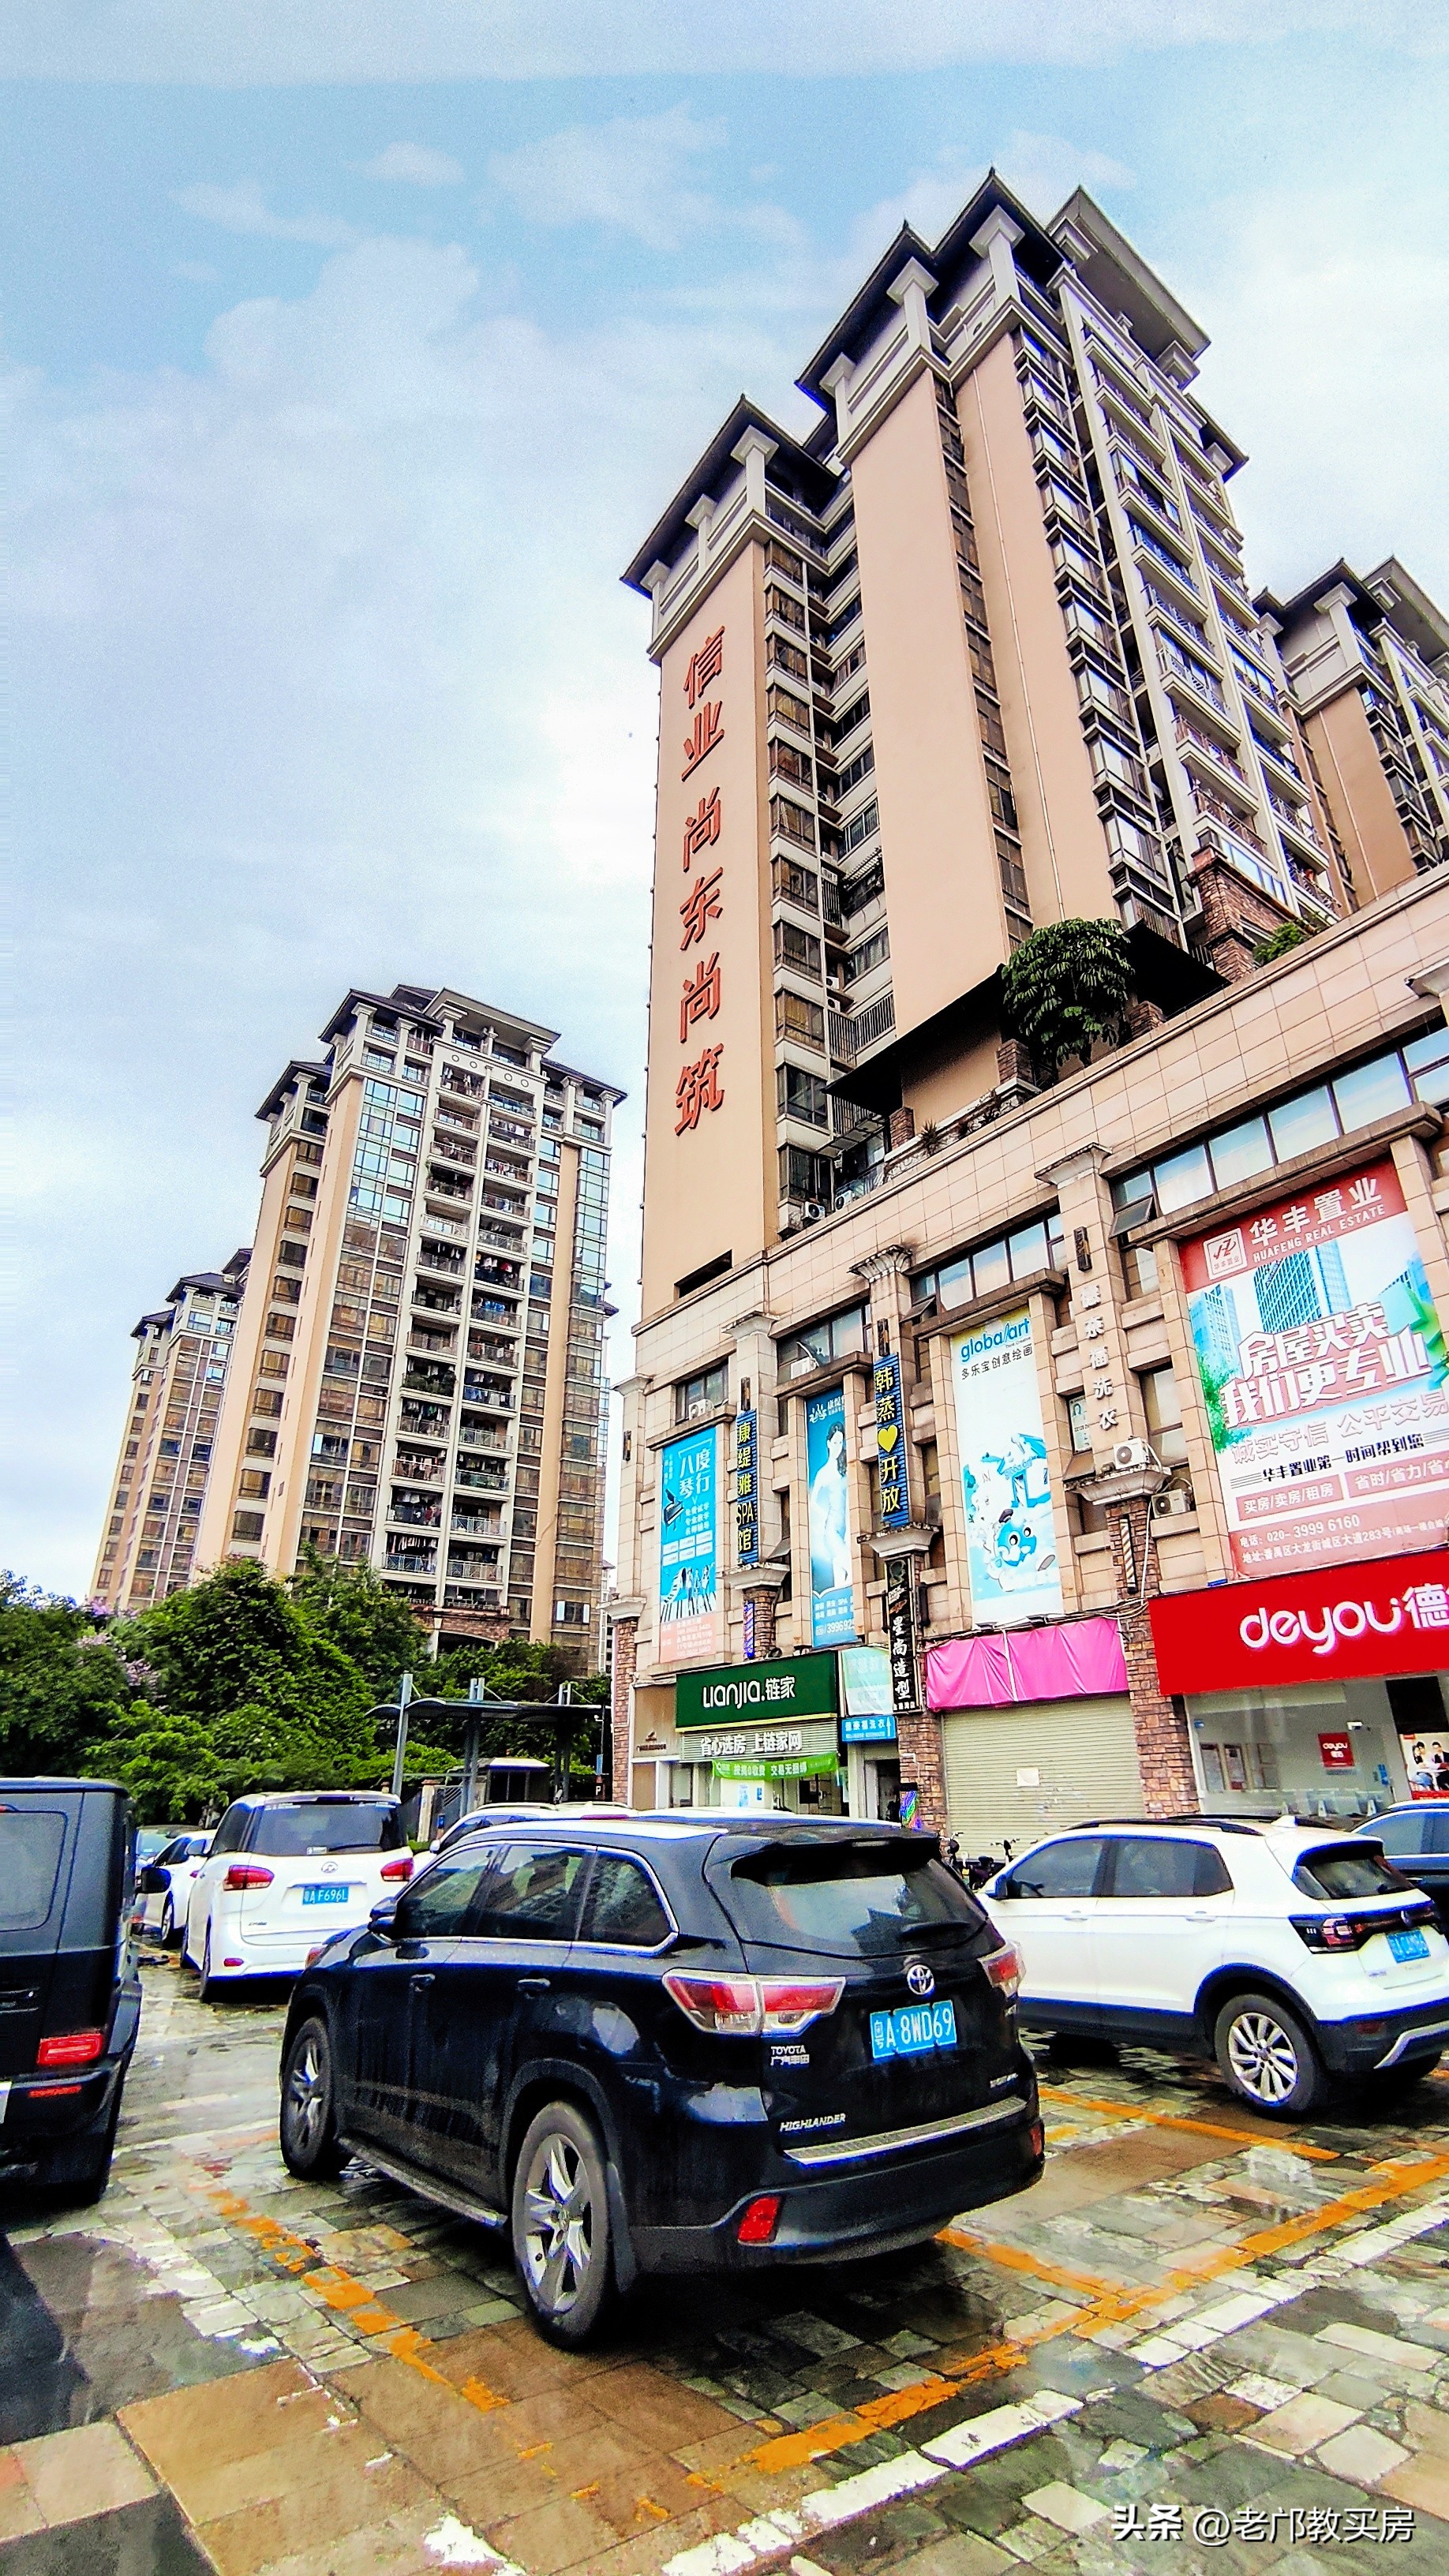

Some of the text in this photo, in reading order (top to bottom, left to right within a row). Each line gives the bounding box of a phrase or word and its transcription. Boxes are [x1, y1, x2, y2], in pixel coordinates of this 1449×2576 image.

[676, 625, 725, 1136] 信业尚东尚筑
[1249, 1177, 1381, 1247] 华丰置业
[1252, 1204, 1386, 1263] HUAFENG REAL ESTATE
[961, 1343, 1033, 1380] 多乐宝创意绘画
[1238, 1301, 1389, 1381] 房屋买卖
[1221, 1324, 1432, 1428] 我们更专业
[1233, 1391, 1449, 1465] 诚实守信 公平交易
[680, 1447, 711, 1479] 八度
[1262, 1432, 1425, 1482] 华丰置业第一时间帮到您
[679, 1470, 712, 1500] 琴行
[736, 1421, 754, 1552] 康缇雅SPA馆
[1243, 1482, 1334, 1515] 买房/卖房/租房
[1266, 1530, 1290, 1543] 020-
[1293, 1521, 1324, 1539] 3999
[1327, 1514, 1360, 1532] 6160
[1239, 1582, 1449, 1654] deyou 德
[893, 1616, 910, 1700] 星尚造型
[701, 1730, 803, 1758] 省心选房 上链家网
[770, 2045, 807, 2056] TOYOTA
[780, 2113, 847, 2132] HIGHLANDER
